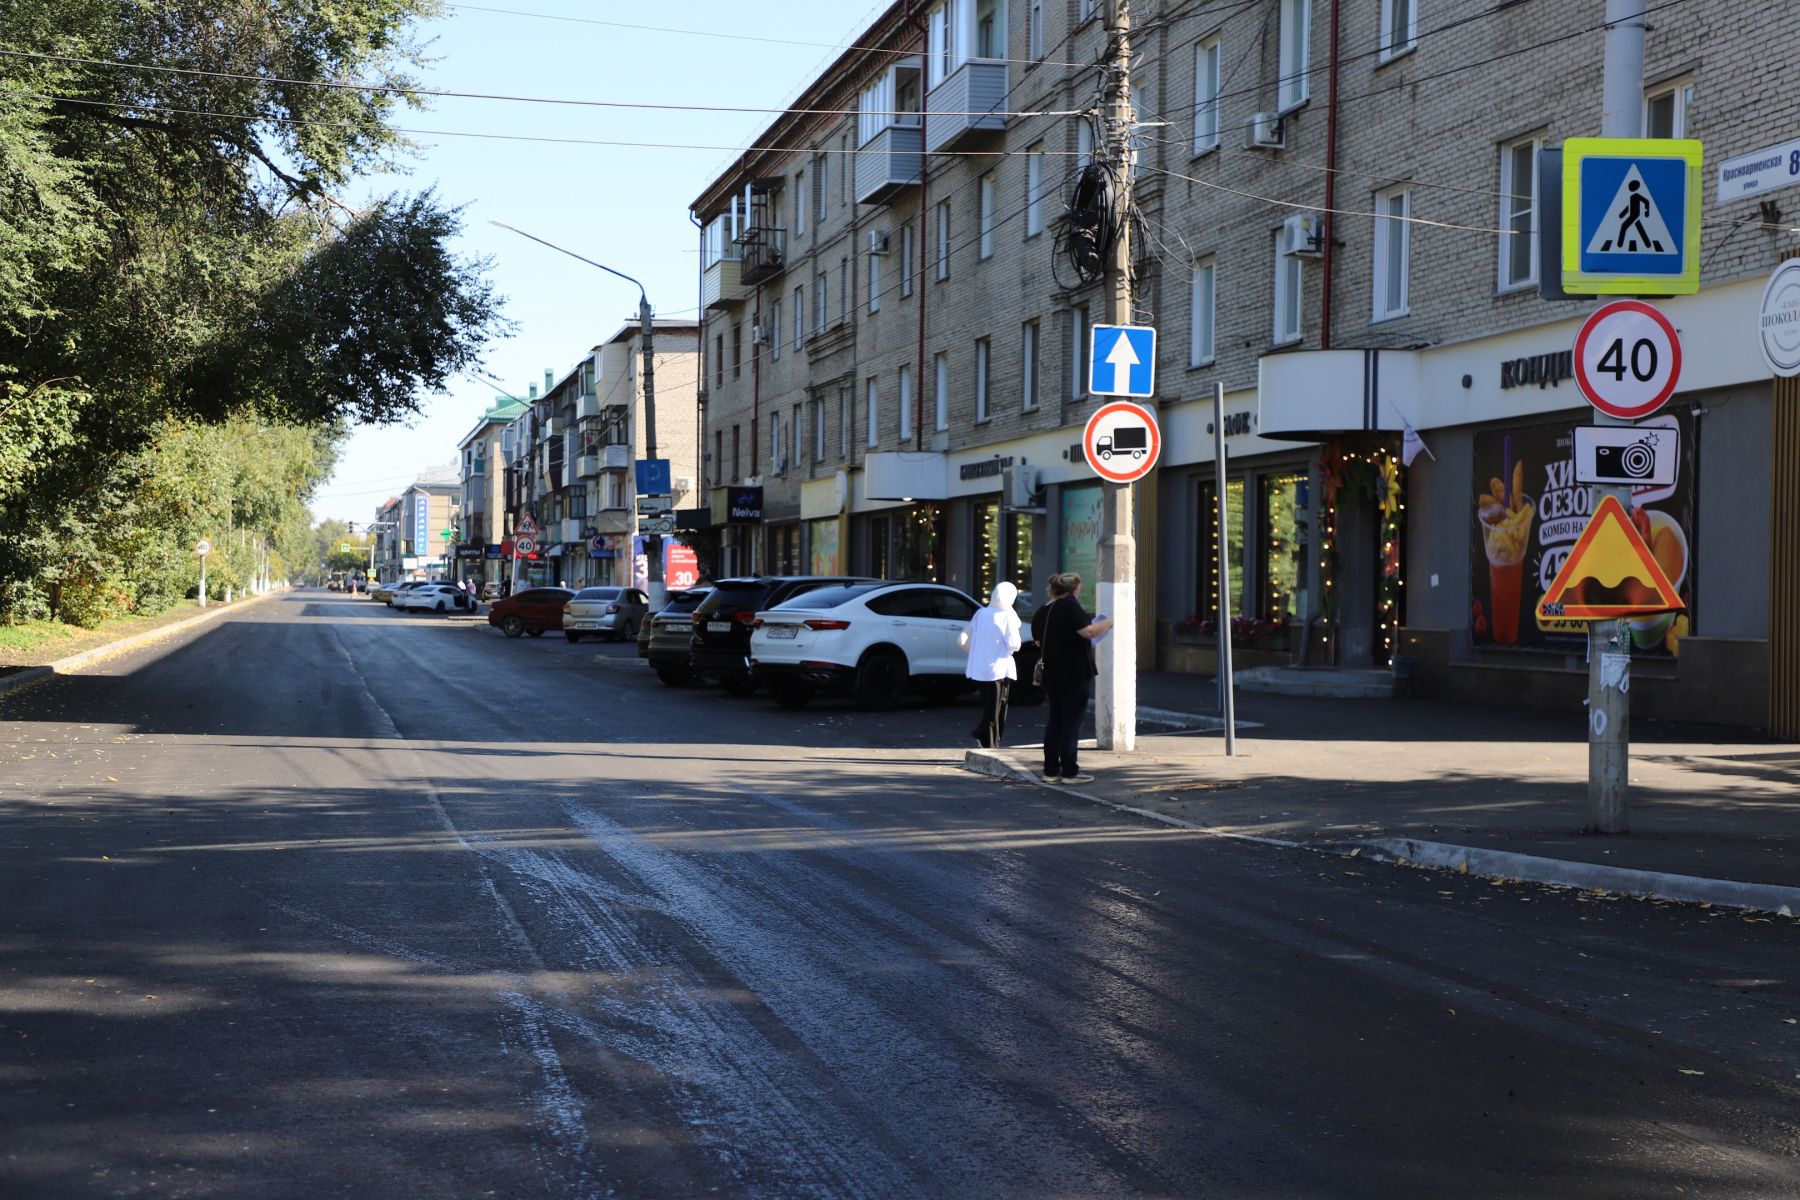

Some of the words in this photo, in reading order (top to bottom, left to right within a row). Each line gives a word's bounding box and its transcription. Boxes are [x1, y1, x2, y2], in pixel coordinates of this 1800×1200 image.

[1762, 310, 1800, 328] ШОКОЛ
[1596, 337, 1659, 382] 40
[1500, 350, 1574, 390] КОНДИ
[1556, 437, 1572, 448] ШОК
[1544, 459, 1576, 492] ХИ
[731, 507, 760, 517] Nelva
[1542, 522, 1571, 539] КОМБО
[518, 541, 532, 551] 40
[675, 571, 693, 586] 30
